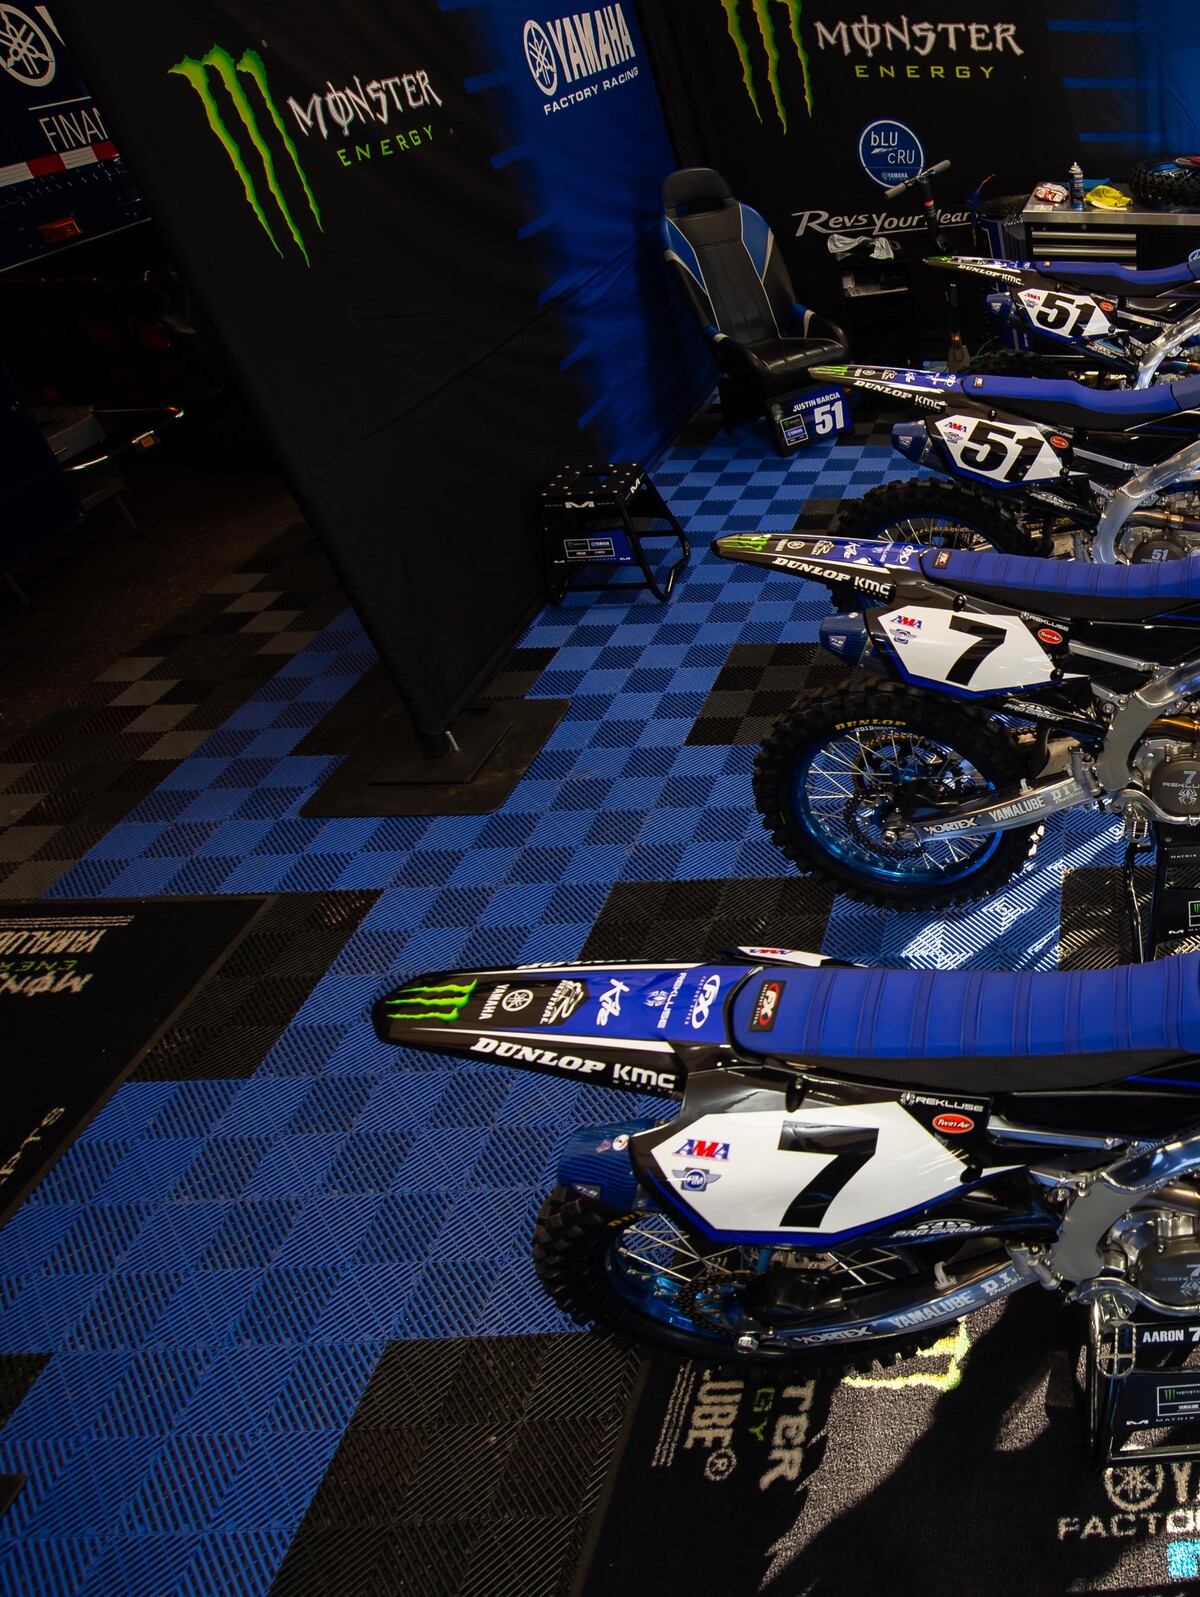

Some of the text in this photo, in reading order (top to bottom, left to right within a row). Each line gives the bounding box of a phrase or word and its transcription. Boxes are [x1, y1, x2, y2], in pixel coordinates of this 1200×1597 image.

[550, 3, 637, 83] YAMAHA
[814, 15, 1023, 57] MONSTER
[855, 65, 994, 79] ENERGY
[287, 69, 442, 141] MONSTER
[543, 67, 639, 116] FACTORY RACING
[336, 124, 434, 168] ENERGY
[957, 264, 1000, 277] DUNLOP
[1036, 292, 1097, 337] 51
[793, 392, 841, 412] JUSTIN BARCIA
[853, 380, 912, 400] DUNLOP
[814, 400, 845, 434] 51
[945, 422, 967, 433] AMA
[960, 420, 1045, 482] 51
[1151, 549, 1168, 559] 51
[772, 557, 890, 595] DUNLOP KMC
[889, 615, 923, 629] AMA
[945, 614, 1007, 687] 7
[834, 719, 908, 731] DUNLOP
[1183, 771, 1197, 783] 7
[989, 795, 1046, 822] YAMALUBE
[479, 983, 511, 1021] YAMAHA
[657, 972, 687, 1029] REKLUSE
[470, 1037, 607, 1074] DUNLOP
[612, 1063, 677, 1090] KMC
[915, 1096, 984, 1113] REKLUSE
[936, 1118, 970, 1129] Twin Air
[675, 1138, 731, 1160] AMA
[777, 1119, 880, 1228] 7
[891, 1223, 993, 1239] PRO CIRCUIT
[890, 1289, 976, 1330] YAMALUBE
[1142, 1329, 1184, 1343] AARON
